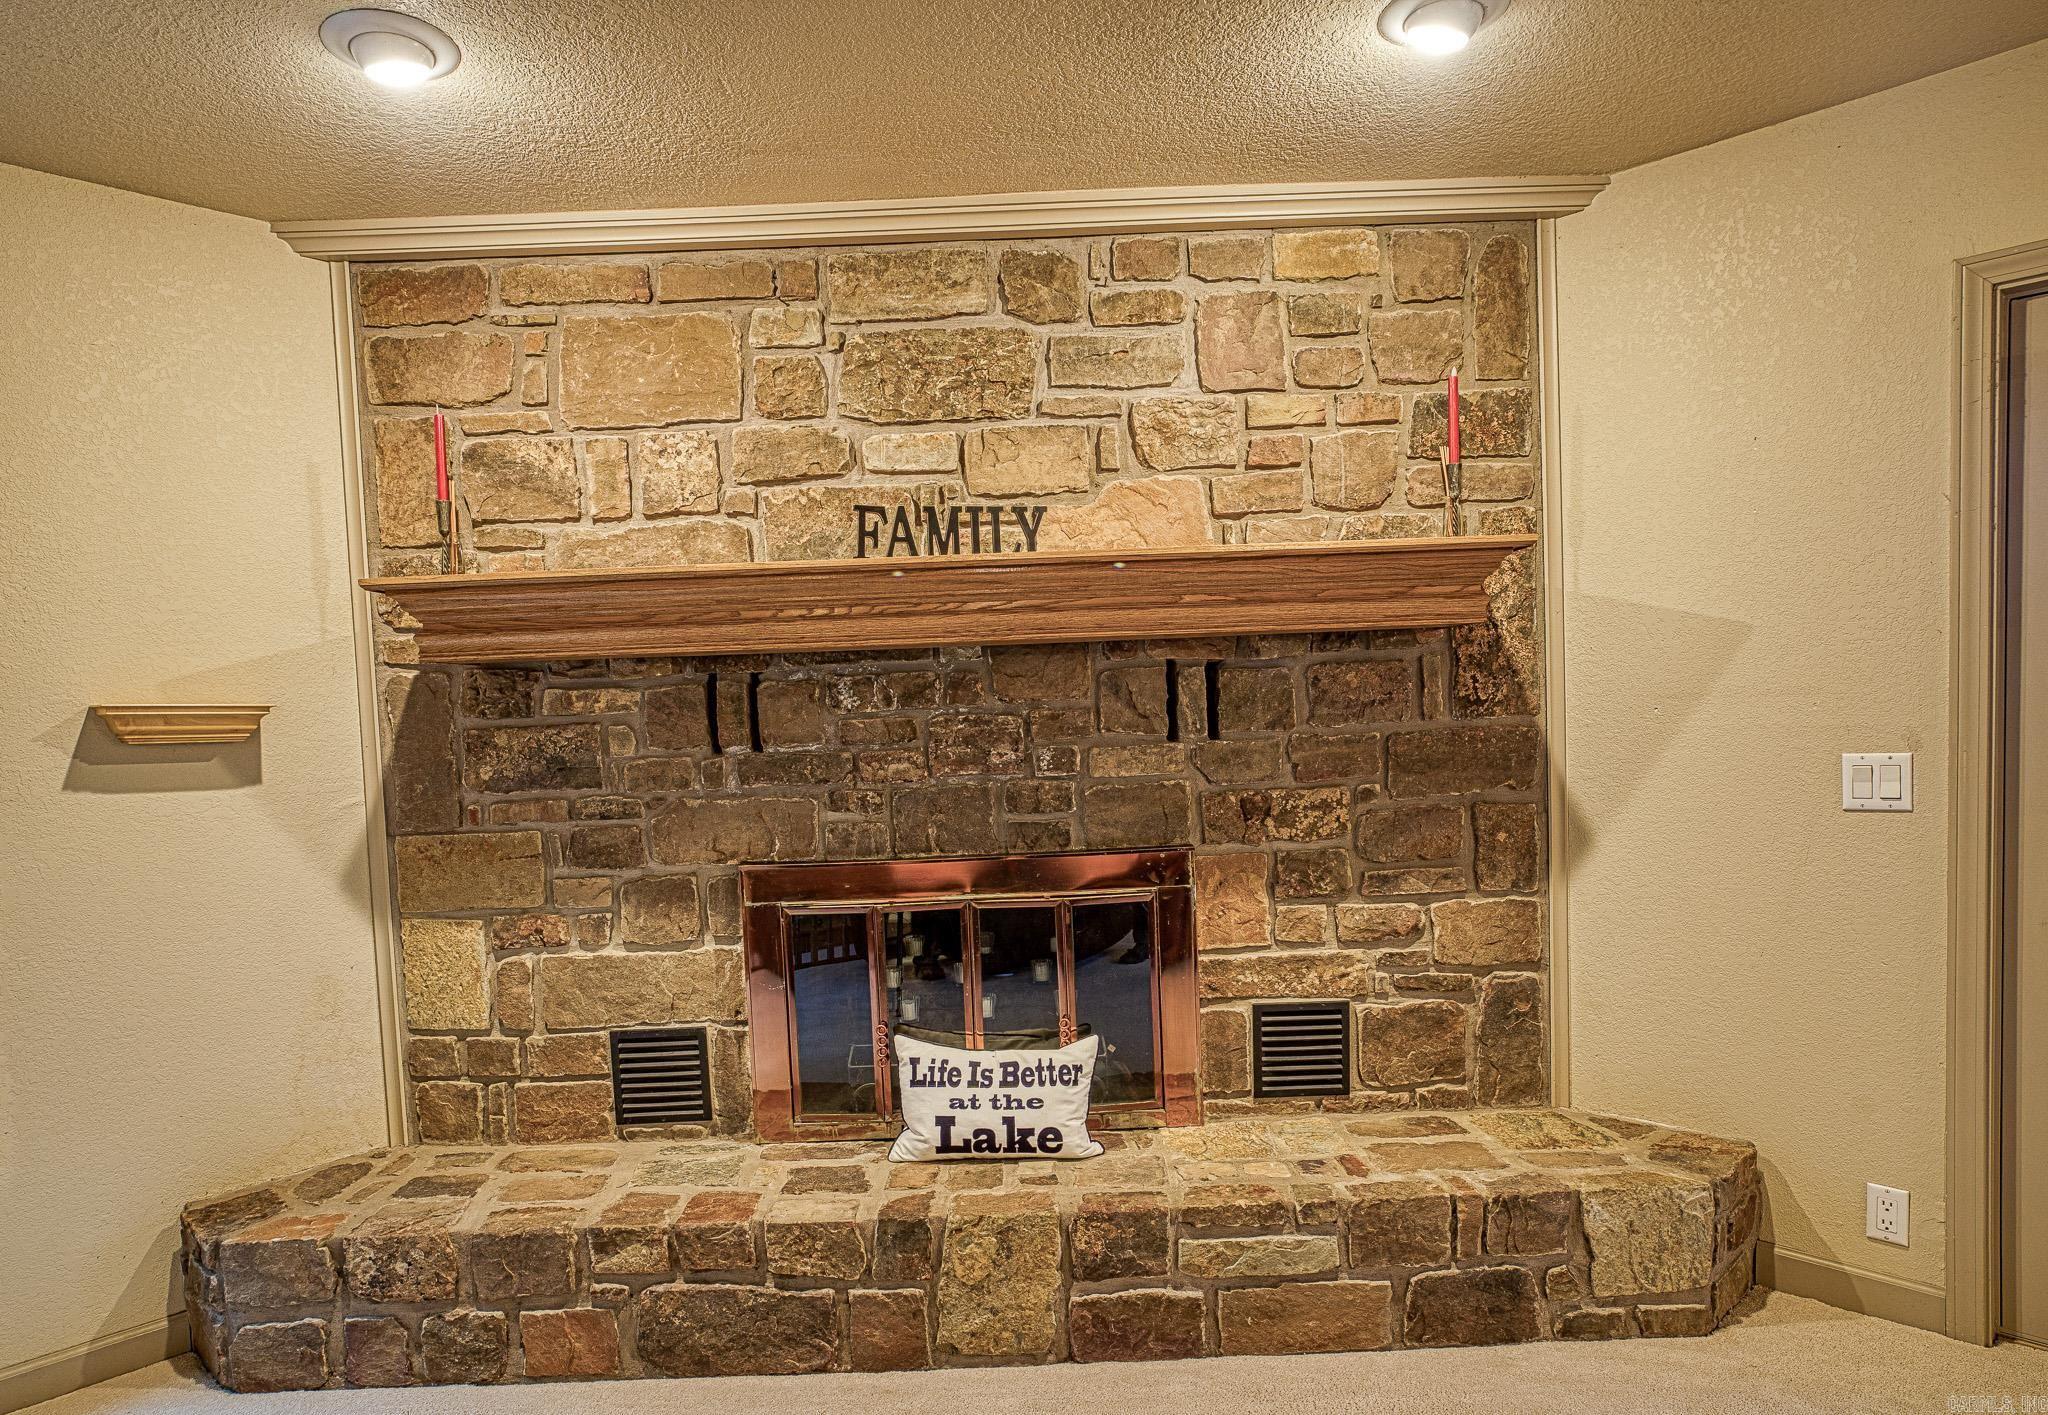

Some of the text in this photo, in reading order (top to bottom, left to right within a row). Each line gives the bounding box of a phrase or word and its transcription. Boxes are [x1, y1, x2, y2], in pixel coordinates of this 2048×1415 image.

[853, 504, 1048, 559] FAMILY
[908, 1056, 1083, 1089] Life Is Better
[948, 1093, 1045, 1110] at the
[935, 1115, 1064, 1154] Lake
